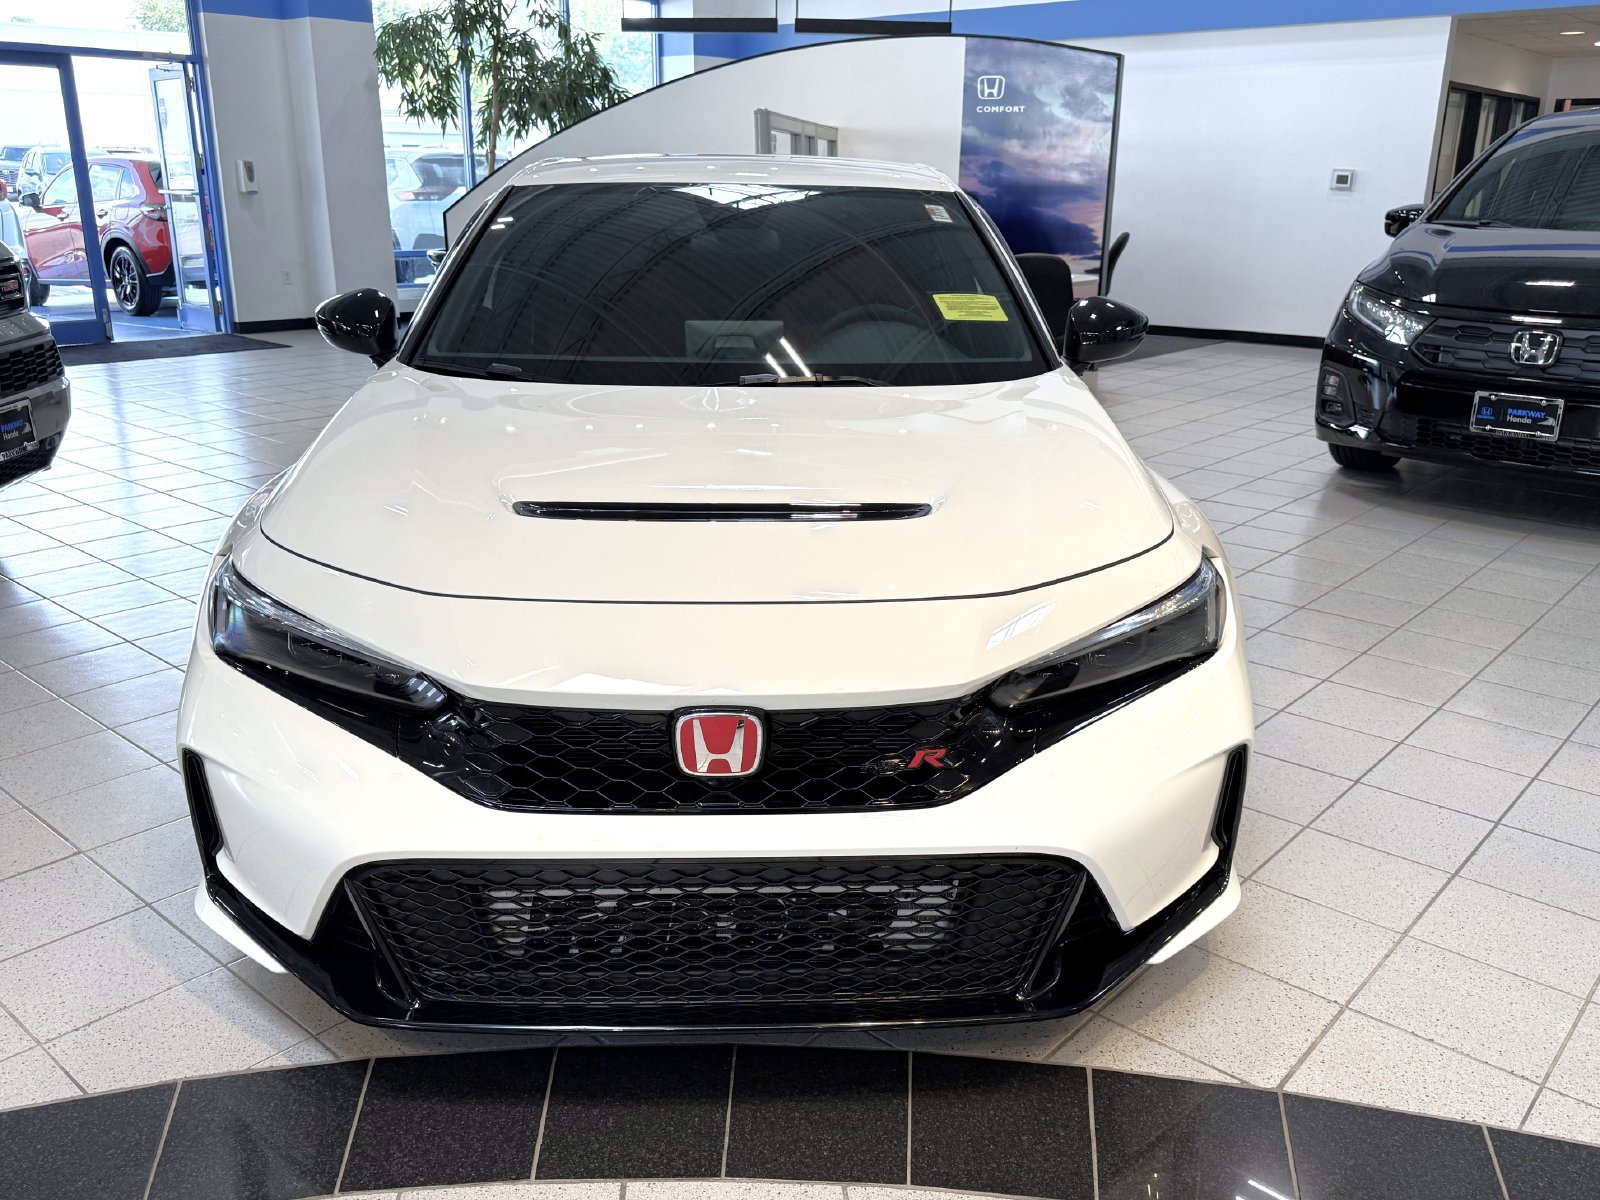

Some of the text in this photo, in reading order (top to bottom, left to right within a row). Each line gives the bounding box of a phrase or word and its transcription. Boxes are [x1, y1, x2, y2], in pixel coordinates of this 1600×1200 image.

[976, 105, 1026, 113] COMFORT
[1507, 408, 1546, 419] PARKWAY
[1506, 414, 1532, 424] Honda
[906, 748, 948, 769] R
